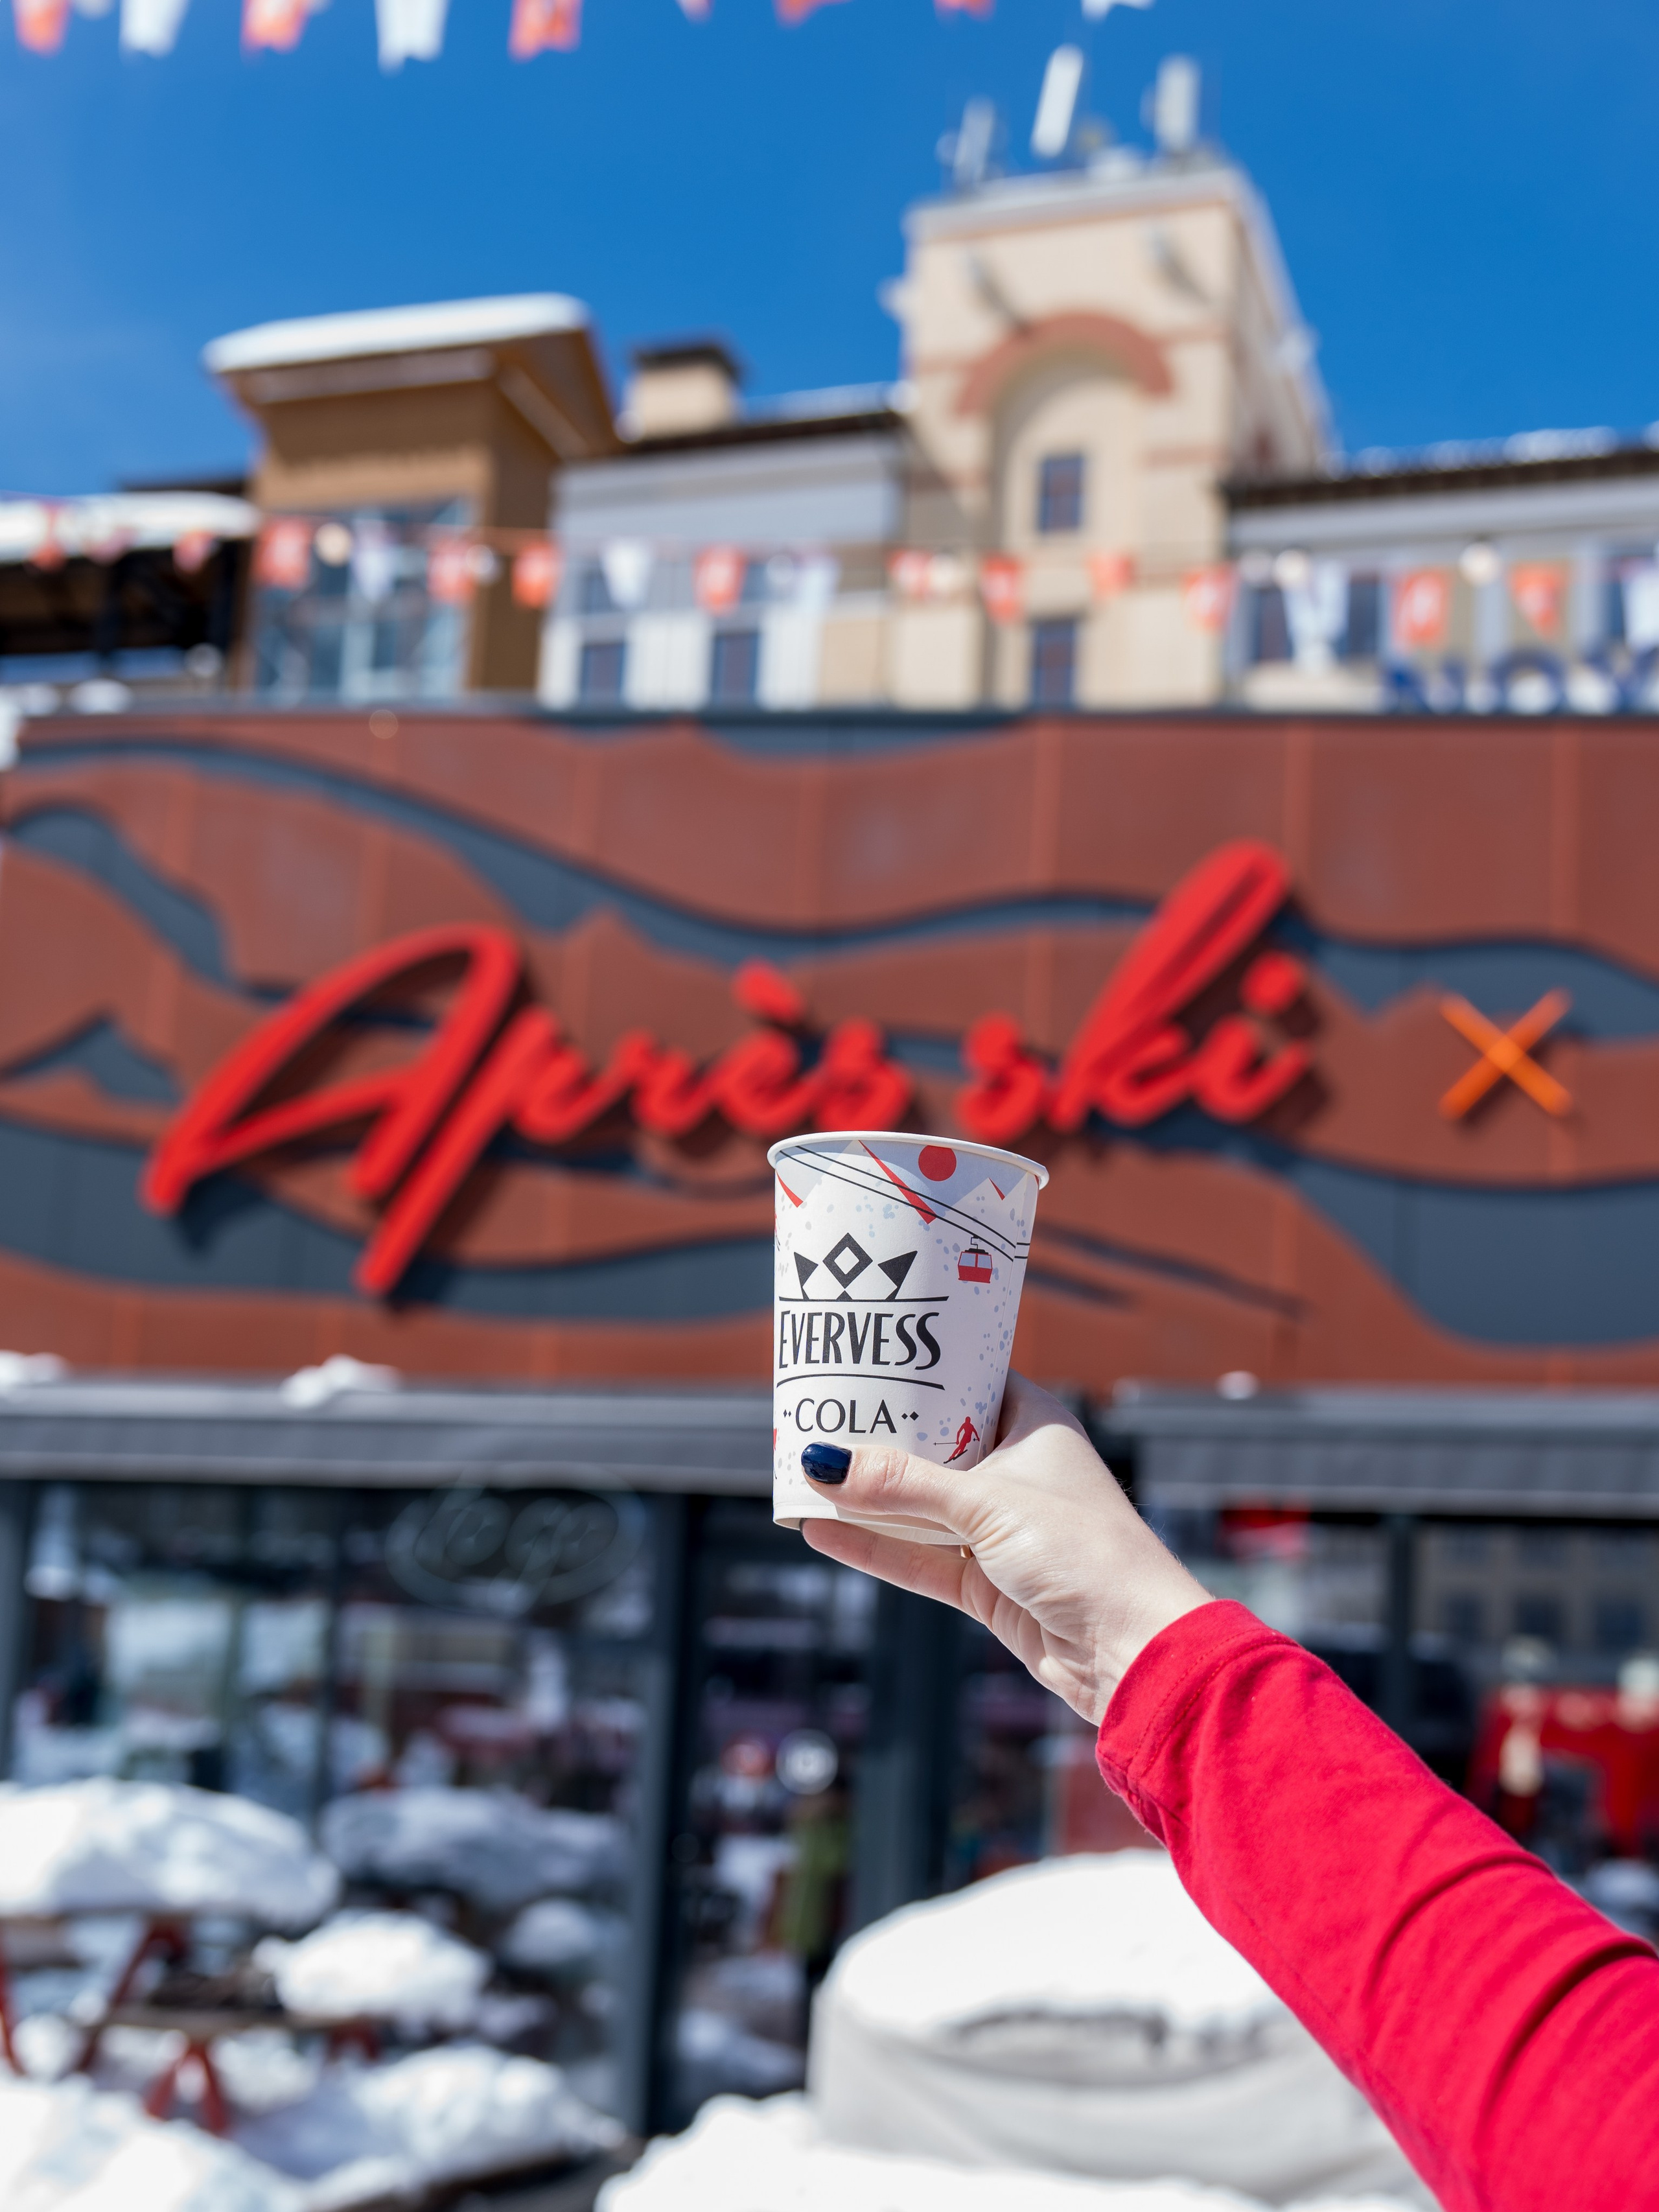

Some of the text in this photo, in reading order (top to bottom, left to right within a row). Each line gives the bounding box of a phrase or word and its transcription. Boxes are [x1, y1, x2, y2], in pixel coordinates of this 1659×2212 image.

[143, 924, 910, 1296] Après
[958, 840, 1310, 1141] ski
[779, 1309, 941, 1370] EVERVESS
[795, 1398, 897, 1434] COLA
